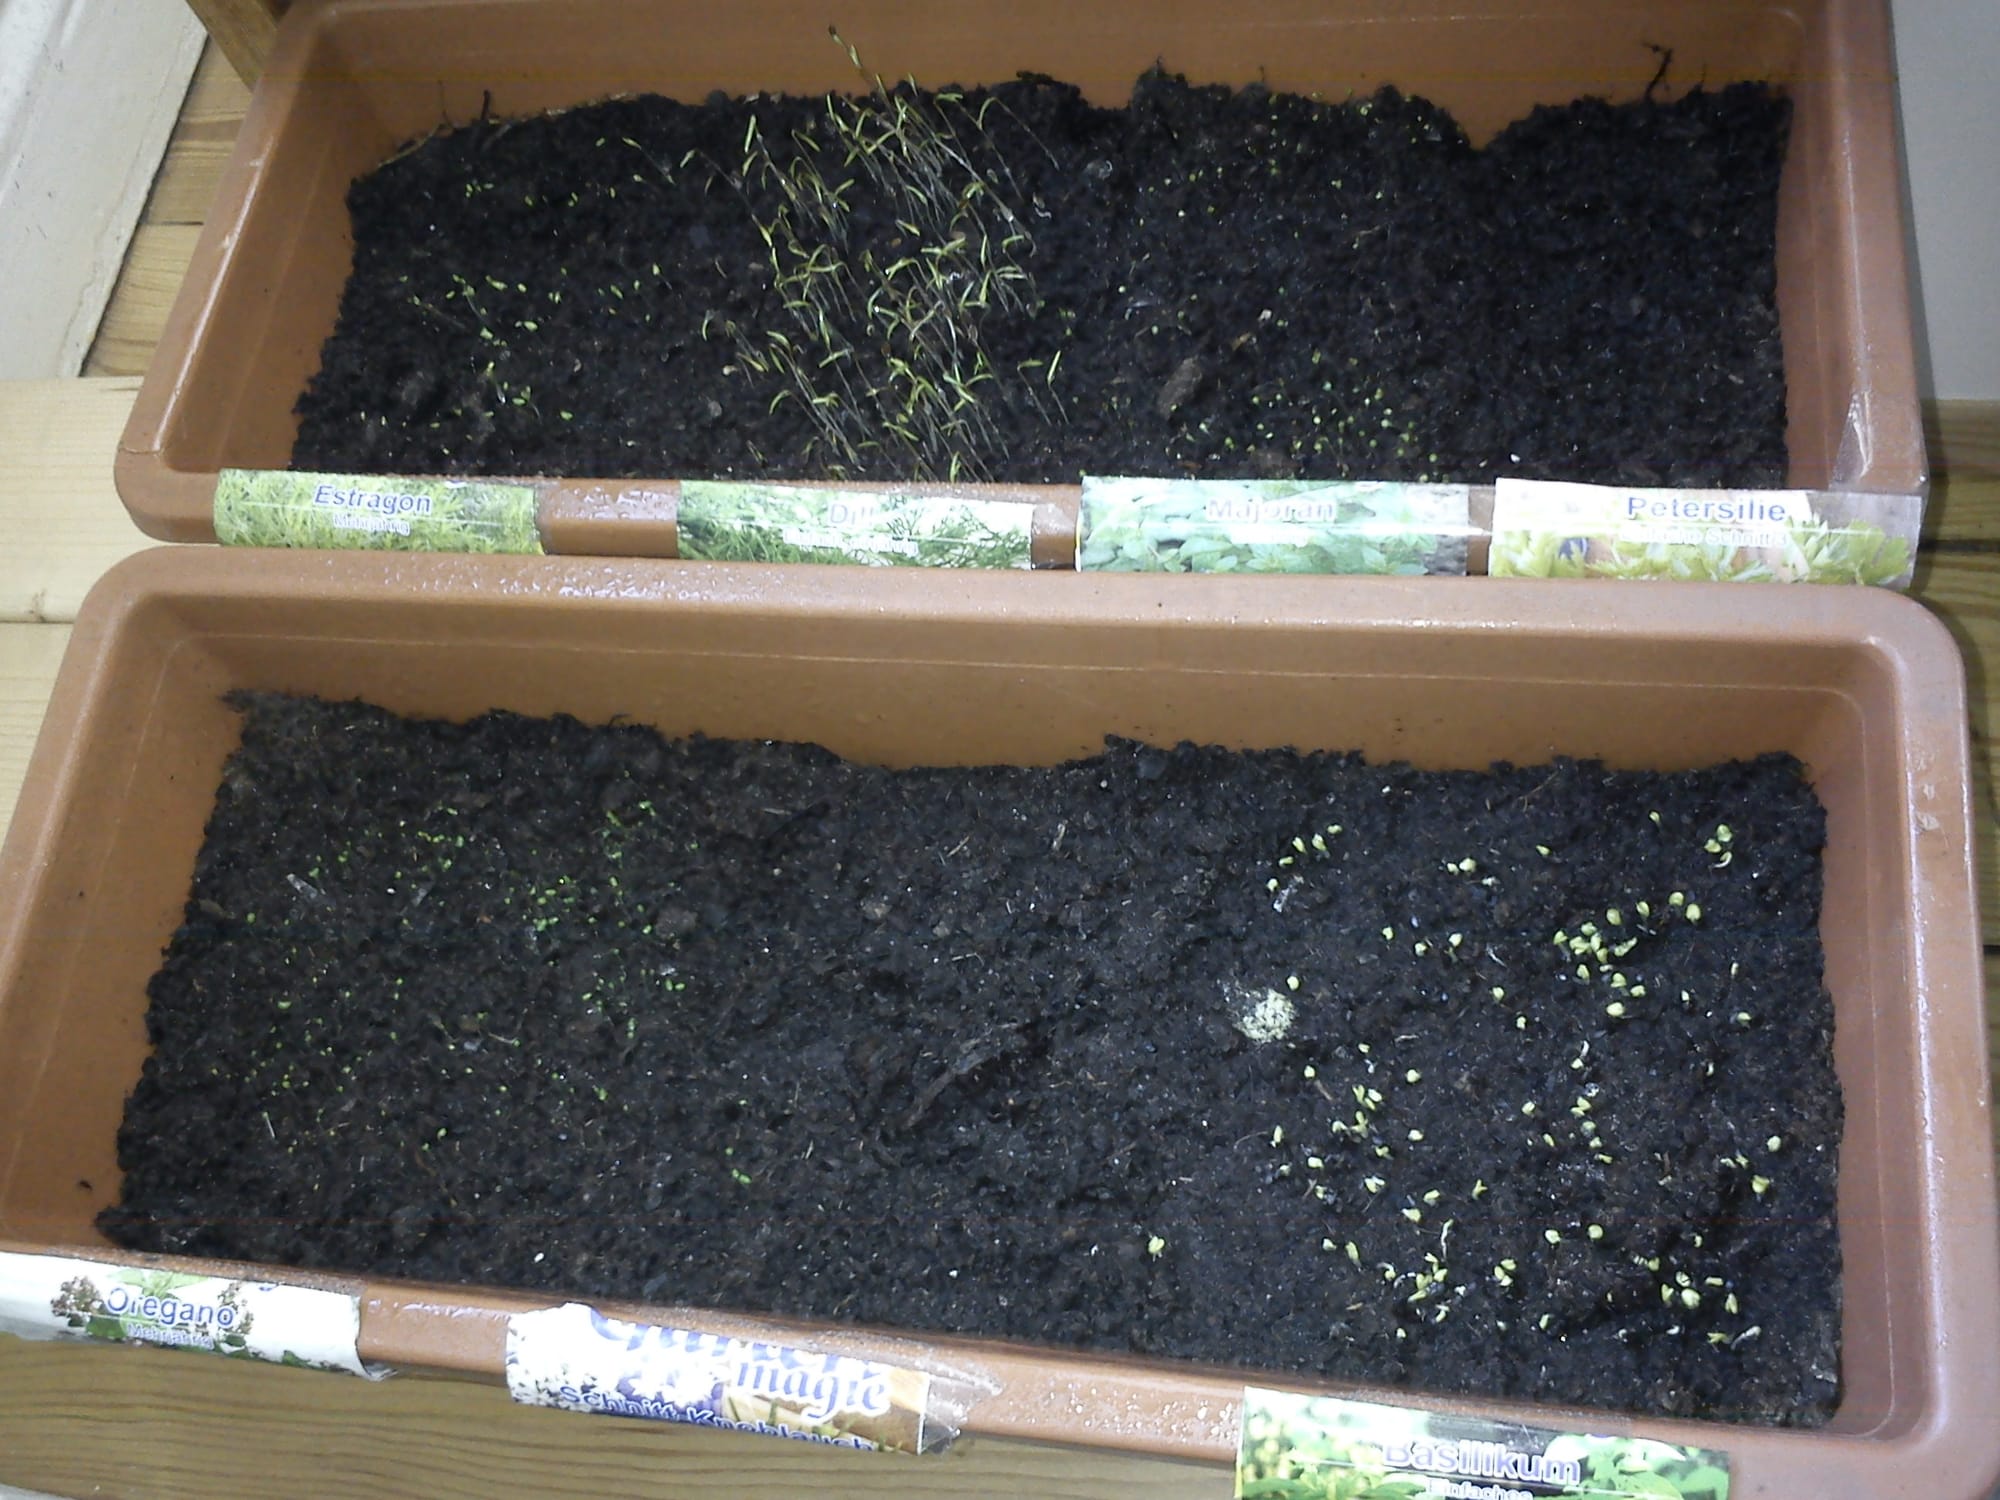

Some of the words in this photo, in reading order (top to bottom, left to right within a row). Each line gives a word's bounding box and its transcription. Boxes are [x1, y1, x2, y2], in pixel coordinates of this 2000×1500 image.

[314, 484, 431, 515] Estragon
[1208, 499, 1334, 523] Majoran
[1627, 496, 1786, 522] Petersilie
[107, 1287, 235, 1326] Oregano
[1384, 1443, 1579, 1484] Basilikum
